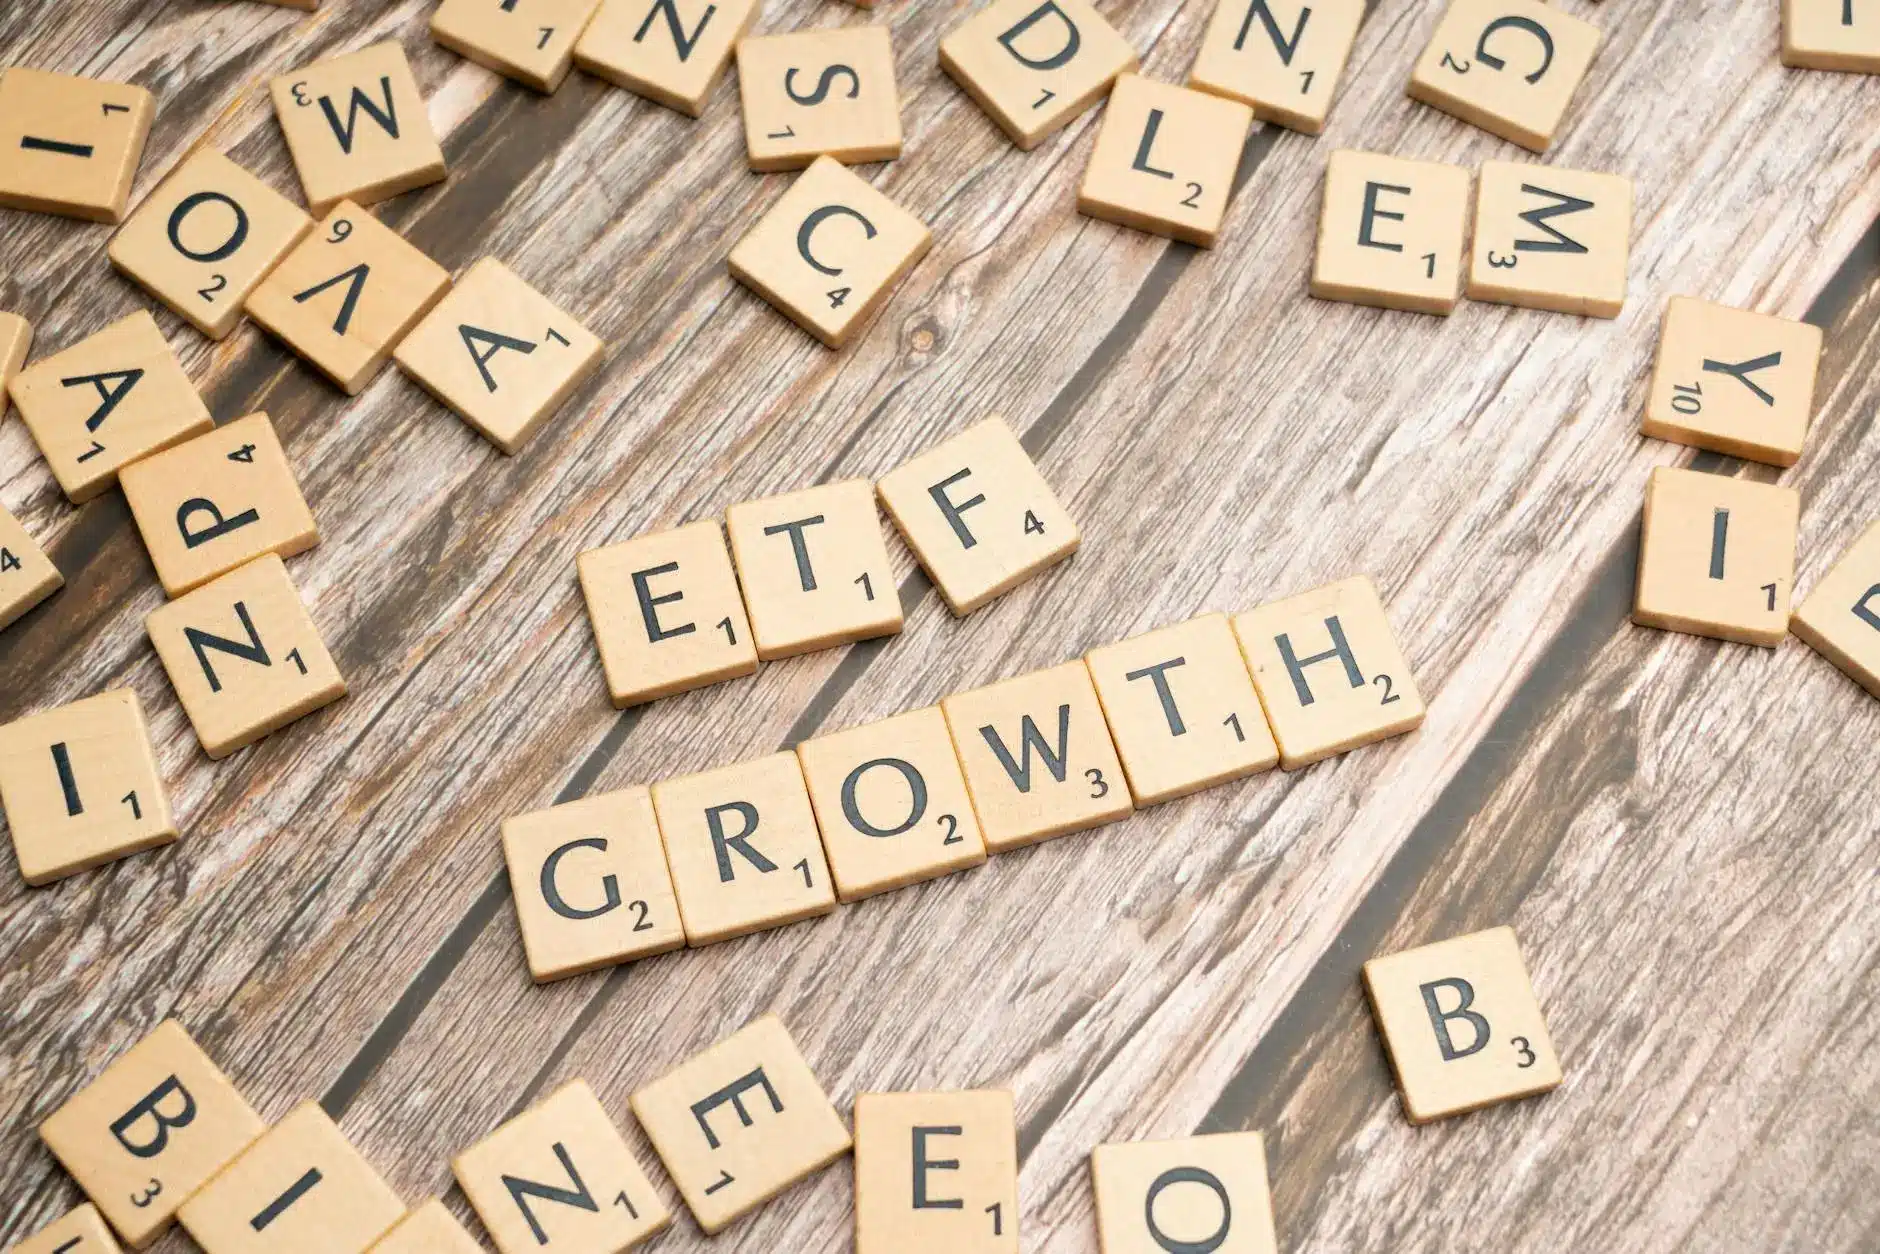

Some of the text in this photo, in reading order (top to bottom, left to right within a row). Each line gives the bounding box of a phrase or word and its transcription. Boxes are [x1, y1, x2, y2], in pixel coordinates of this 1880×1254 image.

[535, 27, 555, 51] 1
[632, 0, 718, 63] N
[996, 0, 1082, 111] D 1
[1232, 0, 1316, 96] N 1
[1439, 15, 1555, 86] G 2
[101, 102, 131, 117] 1
[290, 81, 313, 108] 3
[766, 63, 861, 140] S 1
[1131, 108, 1204, 210] L 2
[166, 191, 250, 303] O 2
[796, 204, 878, 310] C 4
[1356, 180, 1437, 280] E 1
[1486, 182, 1596, 270] M 3
[457, 323, 571, 394] A 1
[1670, 351, 1782, 416] Y 10
[60, 367, 145, 464] A 1
[175, 443, 261, 550] P 4
[1022, 508, 1046, 536] 4
[0, 546, 23, 574] 4
[630, 466, 987, 644] ETF
[853, 571, 875, 602] 1
[1708, 507, 1777, 612] I 1
[182, 600, 309, 694] N 1
[715, 616, 737, 646] 1
[1222, 712, 1246, 743] 1
[1371, 673, 1401, 706] 2
[49, 741, 143, 821] I 1
[539, 613, 1366, 921] GROWTH
[1084, 768, 1109, 799] 3
[936, 813, 964, 847] 2
[792, 857, 814, 889] 1
[628, 899, 654, 933] 2
[1418, 976, 1537, 1069] B 3
[108, 1073, 197, 1209] B 3
[689, 1065, 785, 1196] E 1
[249, 1166, 324, 1233] I
[500, 1141, 639, 1247] N 1
[911, 1125, 1003, 1237] E 1
[1144, 1165, 1233, 1254] O
